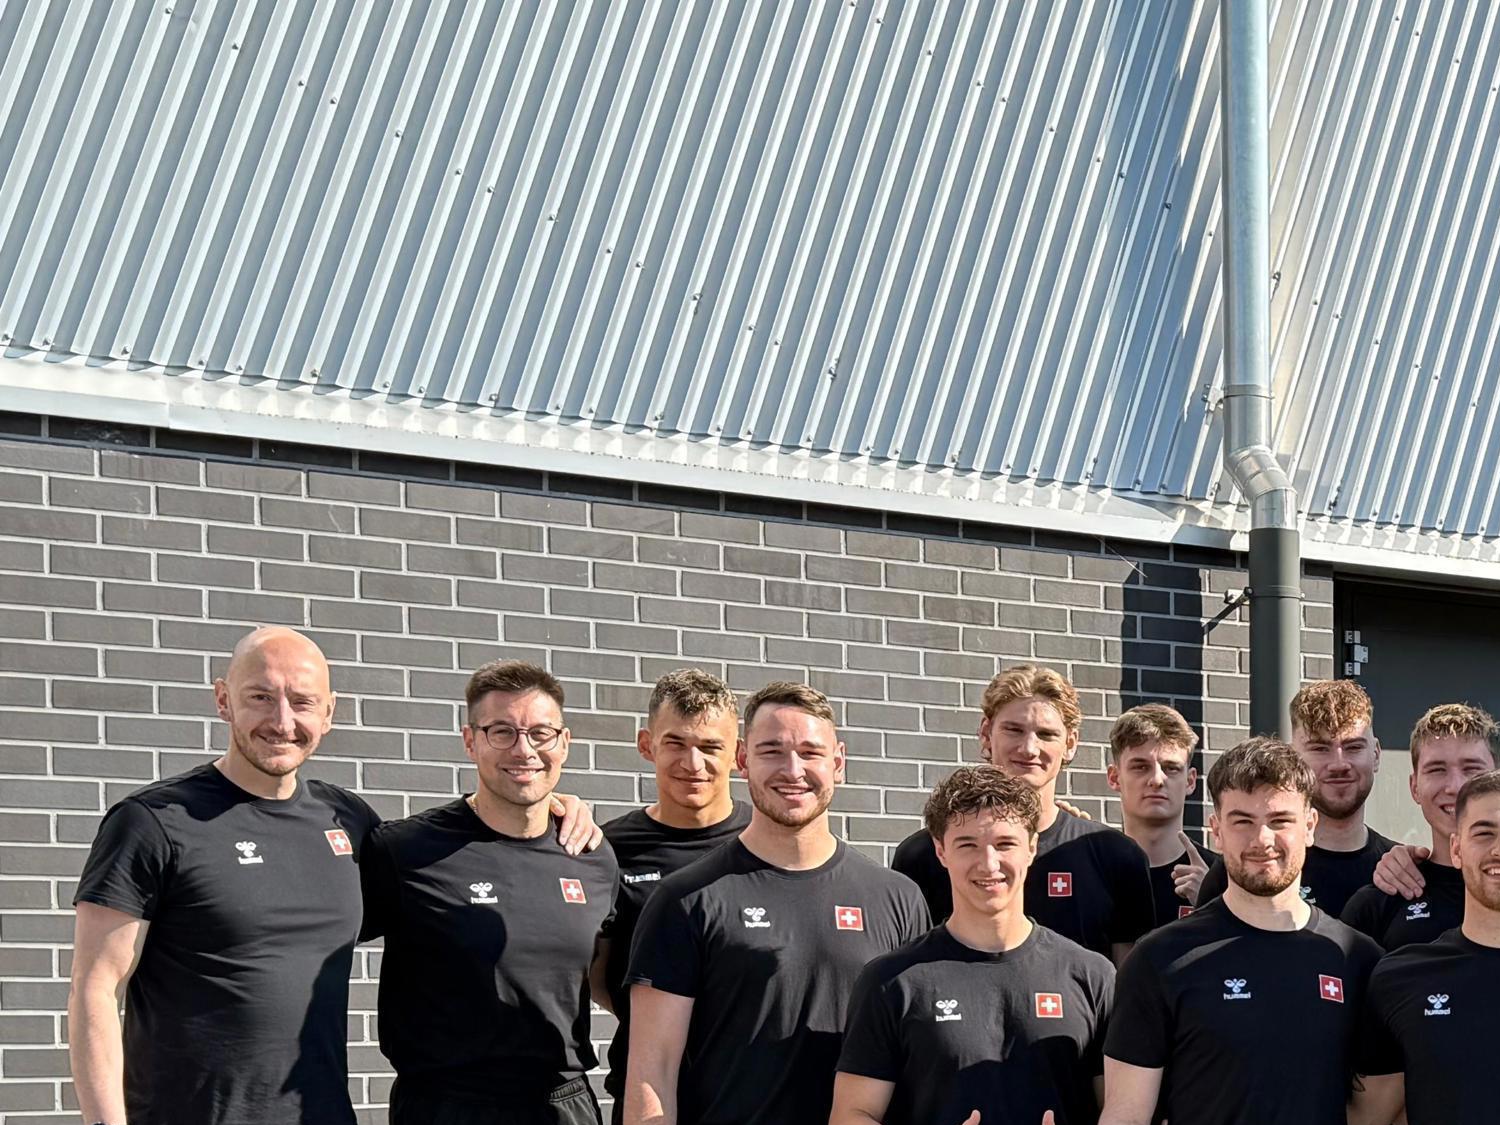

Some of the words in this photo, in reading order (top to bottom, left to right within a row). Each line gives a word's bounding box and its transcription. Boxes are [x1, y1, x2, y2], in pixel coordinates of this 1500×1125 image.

[624, 871, 661, 884] hummel
[471, 896, 498, 905] hummel
[1406, 911, 1430, 921] hummel
[1223, 992, 1251, 1001] hummel
[1424, 1007, 1451, 1017] hummel
